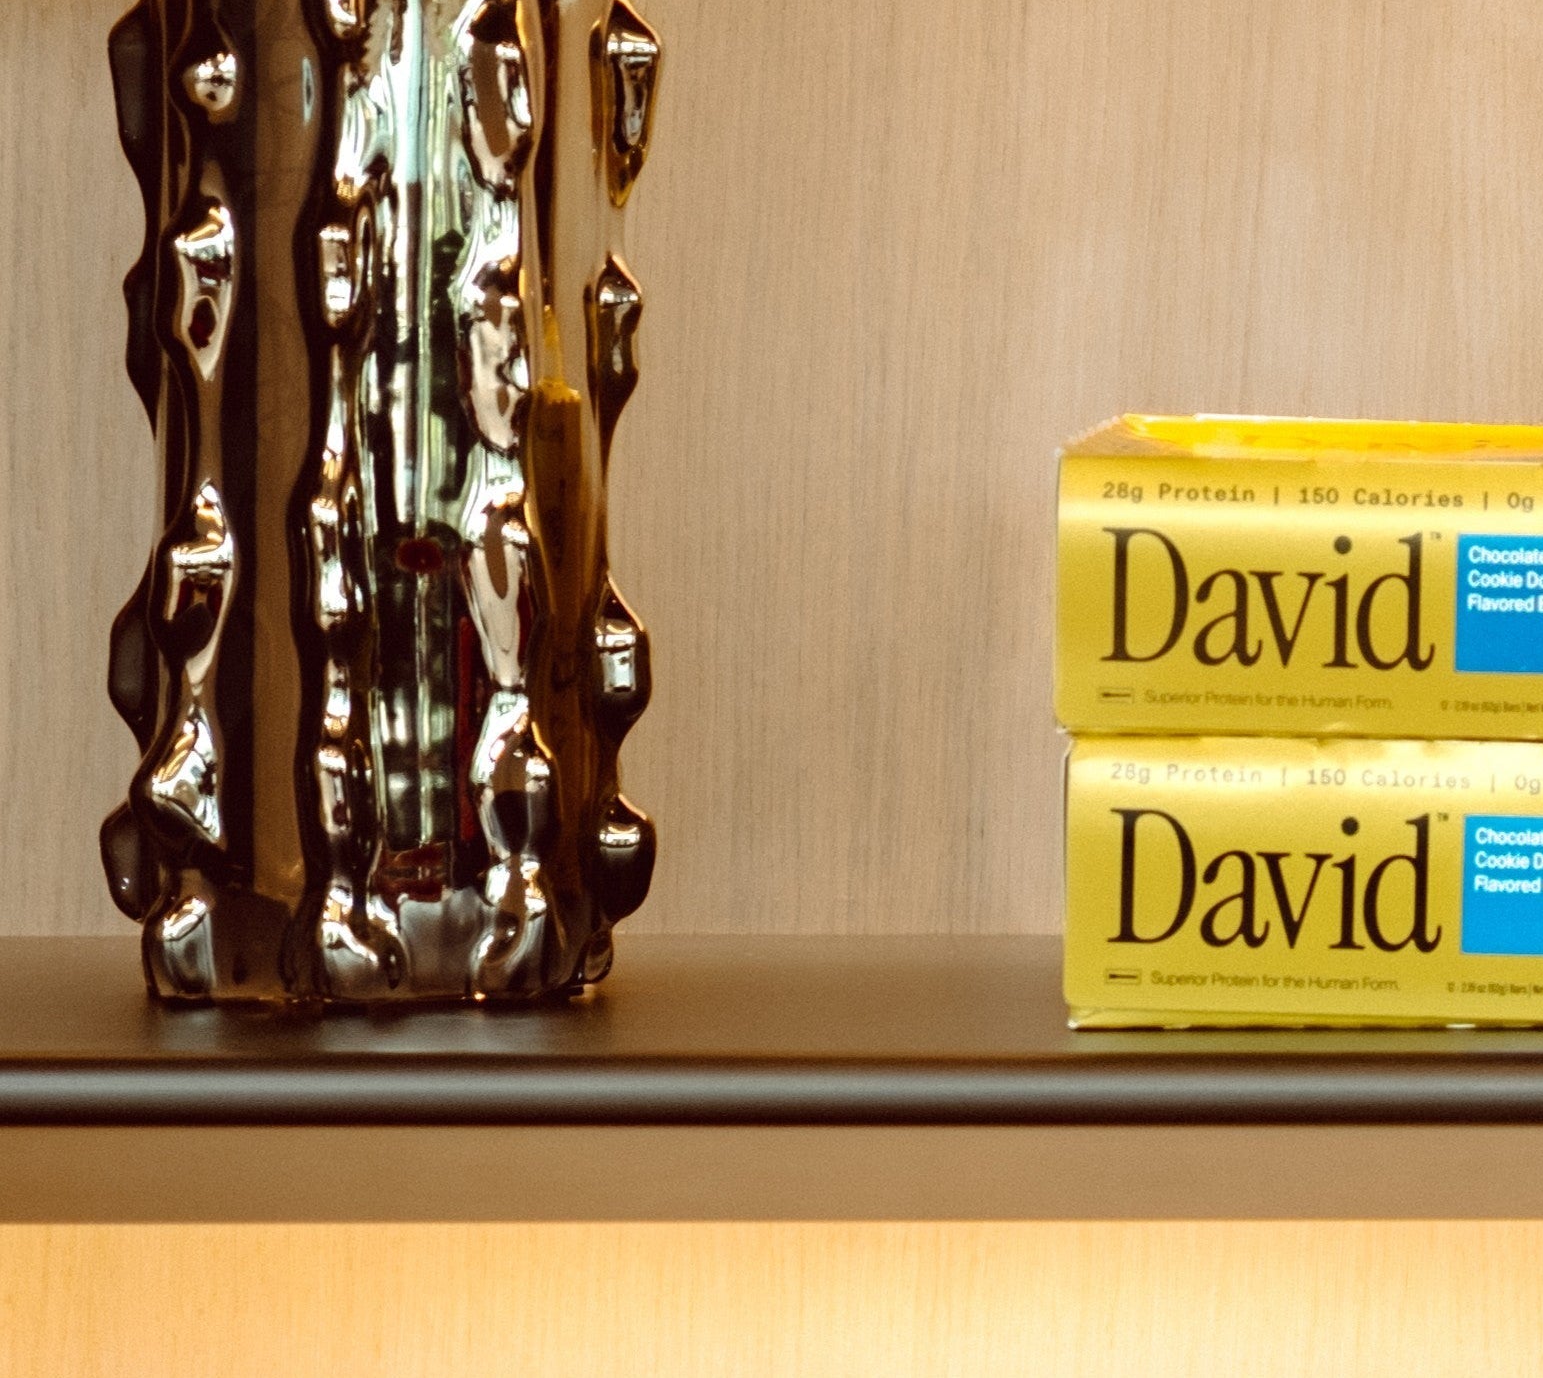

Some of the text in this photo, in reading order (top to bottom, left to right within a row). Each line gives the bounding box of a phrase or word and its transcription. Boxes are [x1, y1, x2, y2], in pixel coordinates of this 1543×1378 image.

[1102, 481, 1143, 504] 28g
[1158, 482, 1254, 503] Protein
[1298, 486, 1339, 505] 150
[1353, 487, 1464, 508] Calories
[1506, 491, 1534, 514] 0g
[1467, 568, 1523, 588] Cookie
[1466, 592, 1535, 612] Flavored
[1143, 688, 1201, 706] Superior
[1204, 690, 1253, 705] Protein
[1254, 692, 1273, 706] for
[1275, 693, 1299, 707] the
[1301, 693, 1352, 708] Human
[1109, 762, 1150, 785] 28g
[1165, 763, 1262, 784] Protein
[1306, 767, 1346, 786] 150
[1360, 769, 1471, 790] Calories
[1513, 773, 1541, 796] 0g
[1474, 850, 1530, 870] Cookie
[1473, 874, 1542, 894] Flavored
[1150, 969, 1208, 987] Superior
[1211, 971, 1260, 987] Protein
[1261, 973, 1280, 987] for
[1282, 975, 1305, 988] the
[1307, 975, 1359, 990] Human
